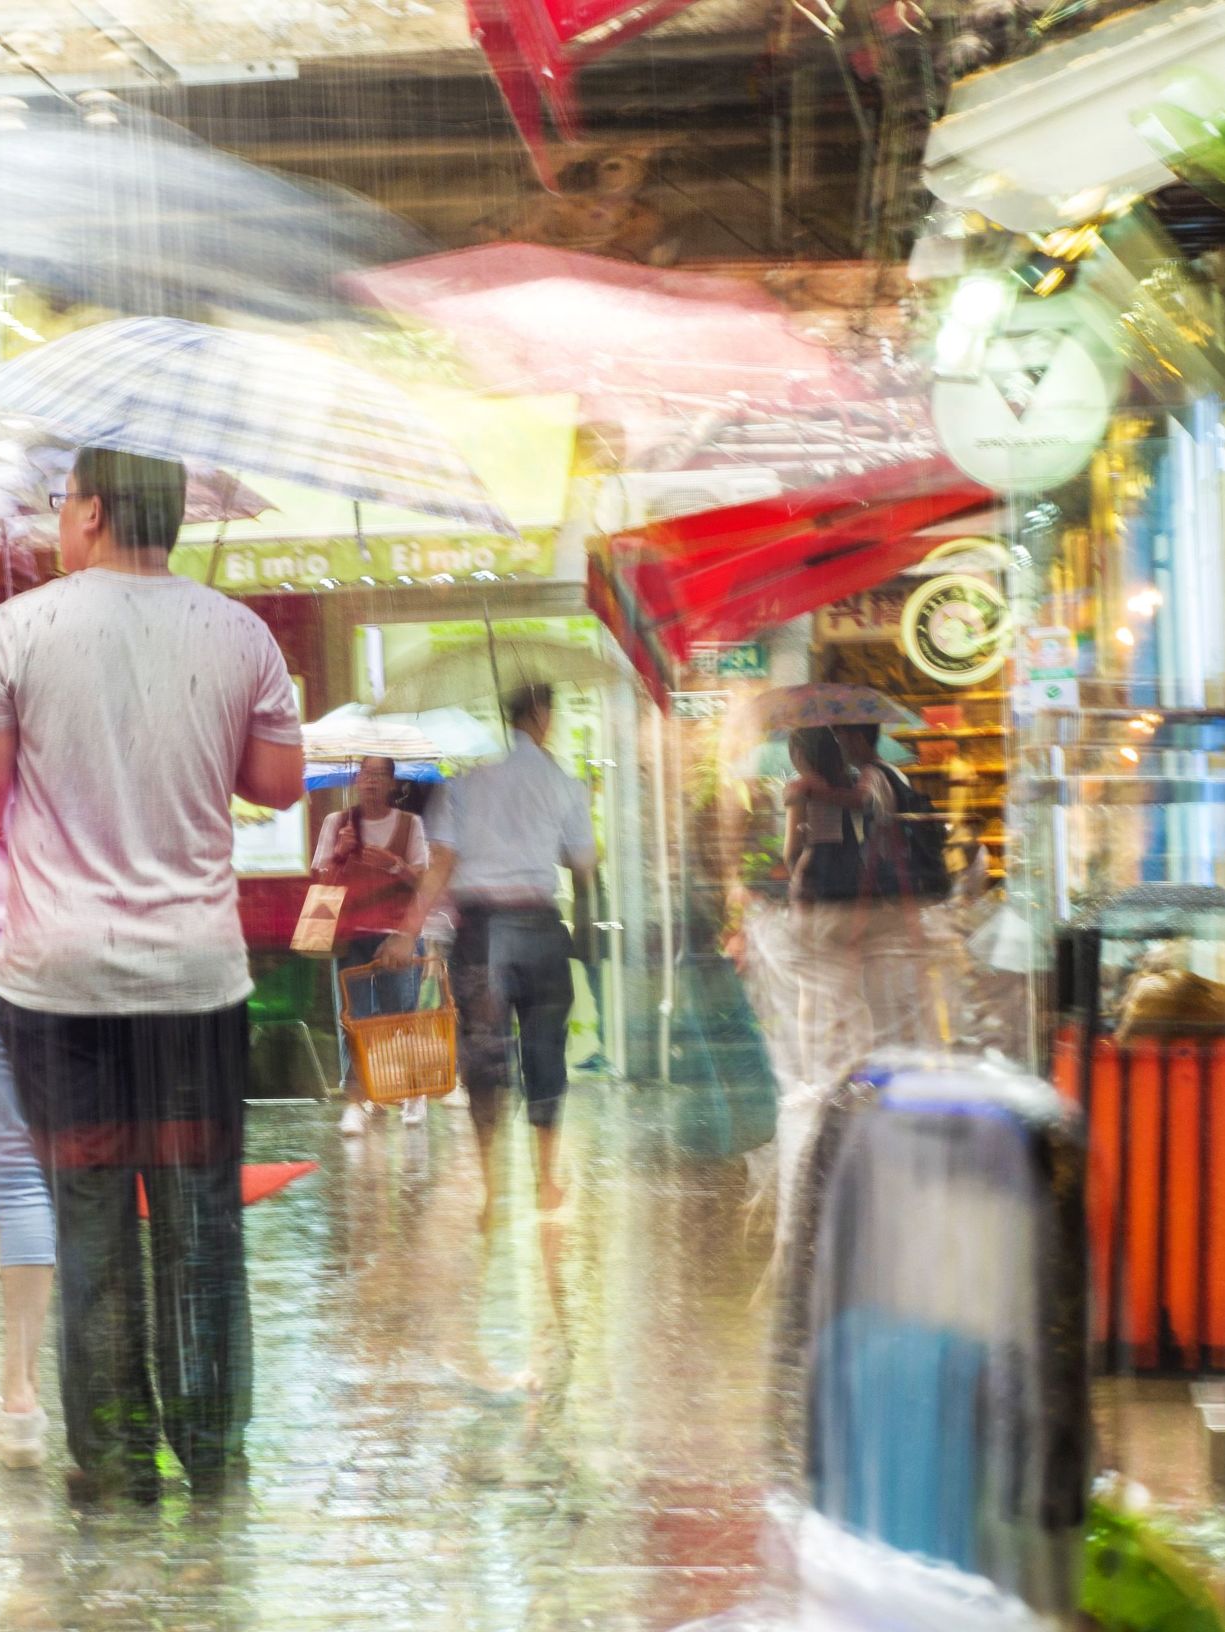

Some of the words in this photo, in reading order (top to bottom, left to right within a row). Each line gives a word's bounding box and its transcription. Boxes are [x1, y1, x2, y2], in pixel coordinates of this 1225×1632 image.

[226, 551, 256, 582] Ei
[261, 546, 328, 579] mio
[390, 542, 421, 573] Ei
[429, 539, 496, 571] mio
